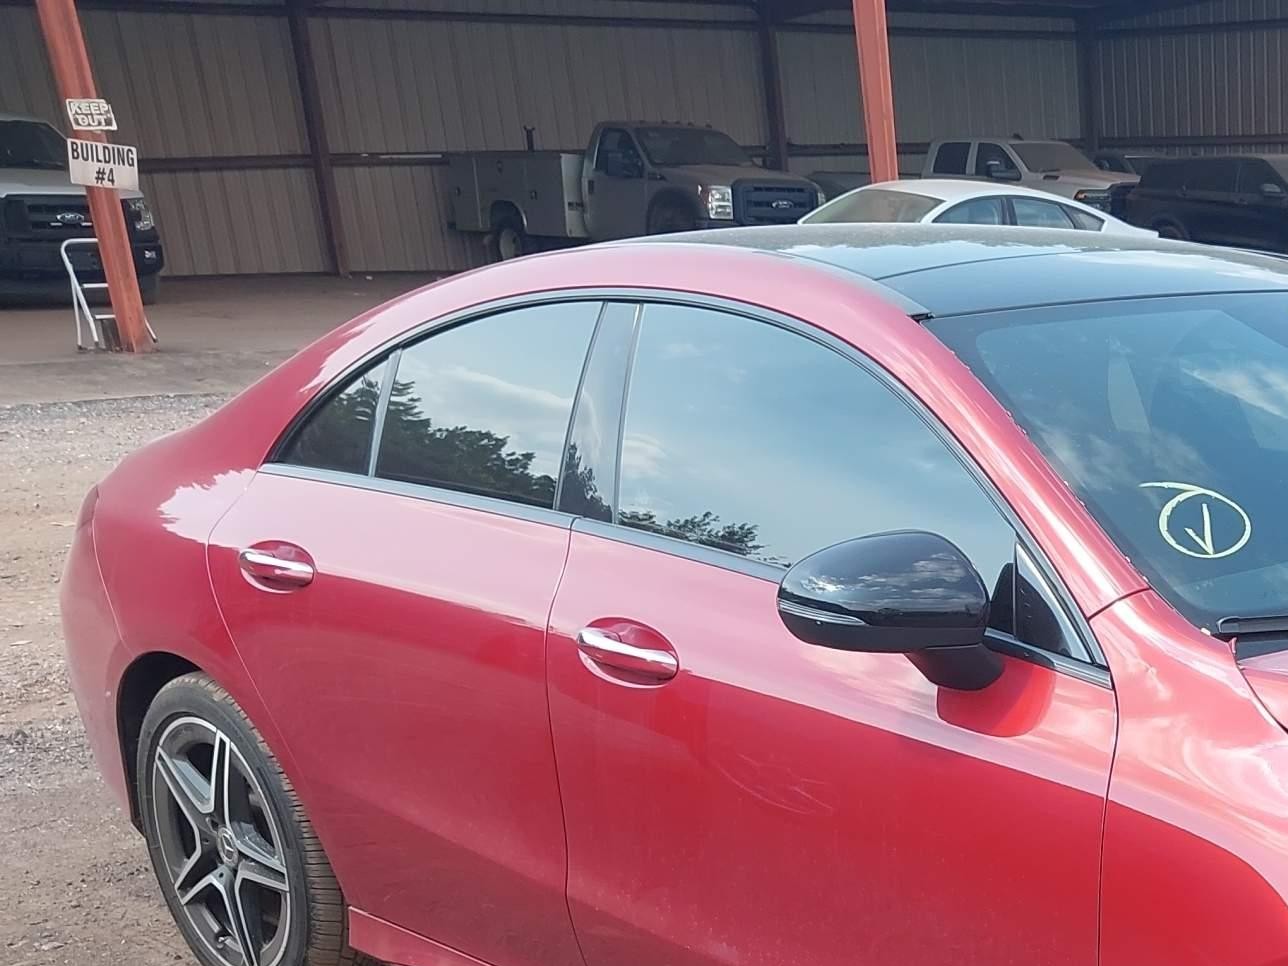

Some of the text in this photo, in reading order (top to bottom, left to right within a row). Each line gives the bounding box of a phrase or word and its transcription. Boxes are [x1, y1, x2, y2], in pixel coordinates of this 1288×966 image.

[70, 102, 109, 114] KEEP
[77, 114, 107, 126] OUT
[70, 141, 135, 167] BUILDING
[95, 167, 115, 186] #4
